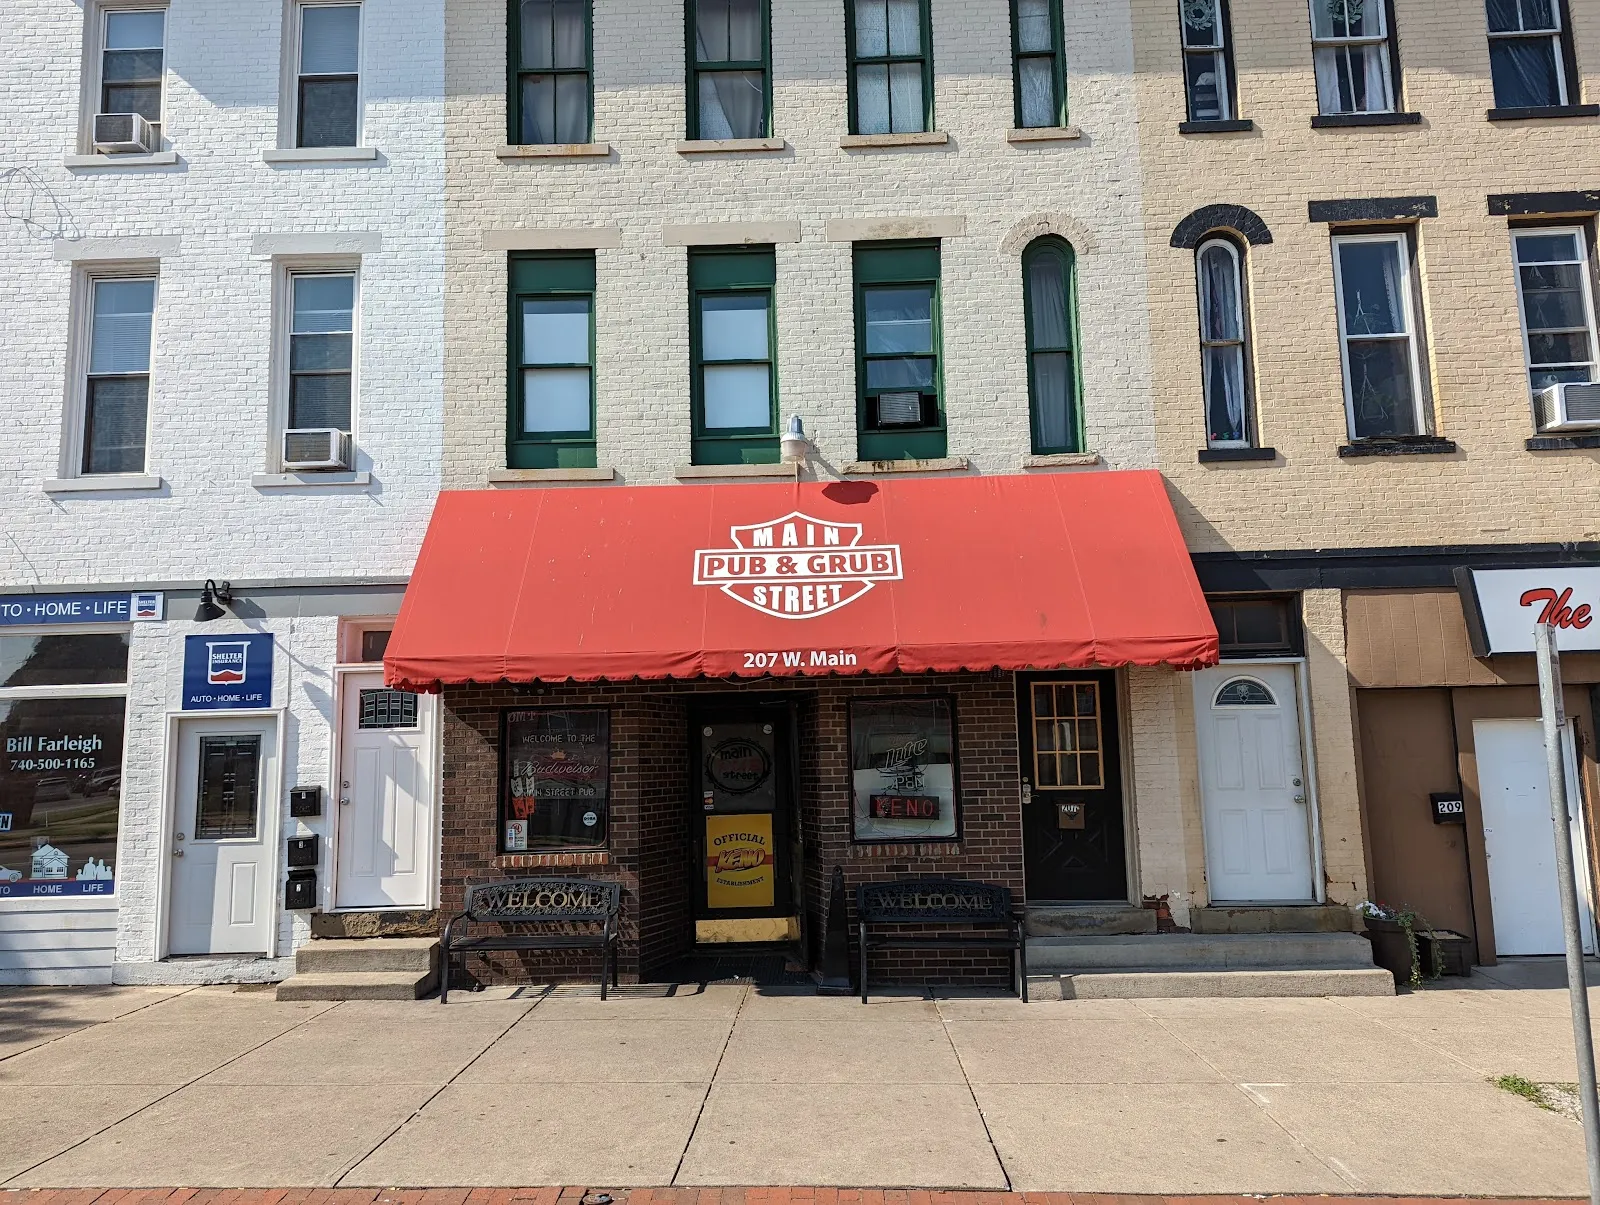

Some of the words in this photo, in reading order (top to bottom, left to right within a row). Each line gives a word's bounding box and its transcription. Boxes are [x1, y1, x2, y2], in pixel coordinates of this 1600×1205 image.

[753, 522, 840, 547] MAIN
[706, 556, 767, 576] PUB
[776, 555, 798, 574] &
[807, 553, 890, 574] GRUB
[753, 584, 843, 613] STREET
[1, 603, 23, 617] TO
[34, 601, 82, 616] HOME
[94, 600, 128, 615] LIFE
[1519, 587, 1593, 630] The
[212, 652, 243, 660] SHELTER
[743, 652, 778, 668] 207
[782, 651, 805, 667] W.
[810, 650, 857, 666] Main
[190, 695, 213, 703] AUTO
[217, 694, 242, 702] HOME
[245, 694, 263, 702] LIFE
[6, 736, 32, 753] Bill
[37, 734, 103, 753] Farleigh
[522, 734, 563, 743] WELCOME
[567, 734, 577, 743] TO
[582, 734, 596, 742] THE
[10, 757, 95, 771] 740-500-1165
[519, 761, 599, 776] Budweiser
[545, 788, 575, 797] STREET
[578, 787, 595, 796] PUB
[1439, 802, 1462, 813] 209
[0, 815, 10, 828] N
[713, 833, 766, 846] OFFICIAL
[715, 848, 766, 874] KENO
[33, 884, 63, 894] HOME
[82, 883, 104, 892] LIFE
[716, 876, 765, 887] ESTABLISHMENT
[485, 890, 601, 911] WELCOME
[877, 892, 993, 909] WELCOME
